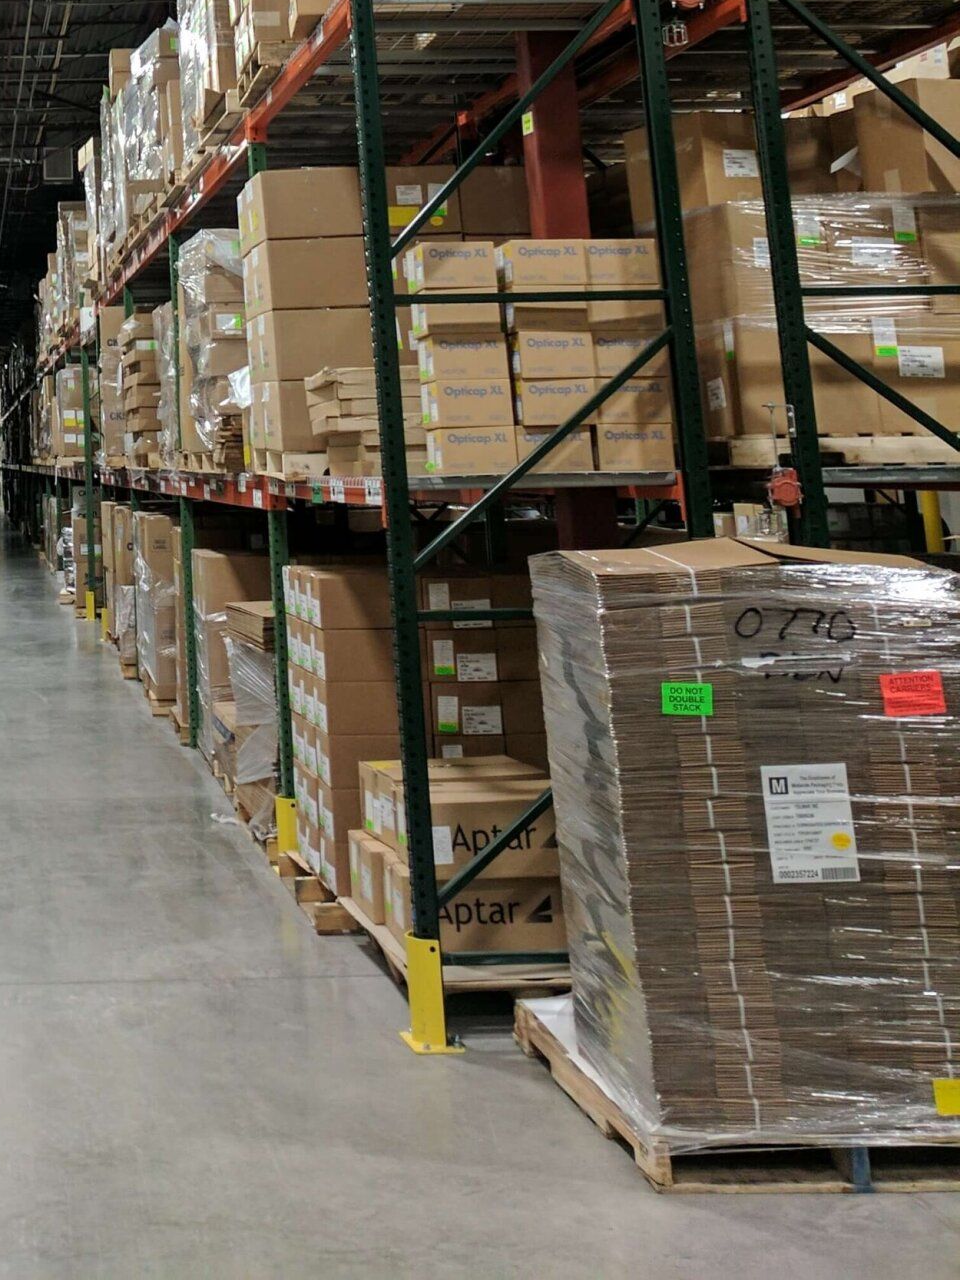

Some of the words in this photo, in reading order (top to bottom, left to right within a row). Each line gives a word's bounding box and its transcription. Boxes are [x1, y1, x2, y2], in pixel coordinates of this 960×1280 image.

[429, 248, 471, 260] Opticap
[474, 248, 488, 258] XL
[518, 246, 561, 257] Opticap
[563, 246, 577, 256] XL
[587, 245, 632, 257] Opticap
[634, 245, 648, 255] XL
[439, 340, 481, 351] Opticap
[484, 340, 499, 349] XL
[527, 338, 569, 349] Opticap
[572, 337, 585, 347] XL
[444, 386, 487, 398] Opticap
[490, 385, 504, 395] XL
[528, 384, 571, 396] Opticap
[574, 384, 588, 394] XL
[447, 433, 491, 445] Opticap
[494, 433, 508, 443] XL
[605, 431, 648, 442] Opticap
[651, 430, 665, 440] XL
[889, 674, 934, 685] ATTENTION
[669, 687, 683, 695] DO
[685, 687, 704, 695] NOT
[669, 695, 706, 703] DOUBLE
[672, 703, 702, 712] STACK
